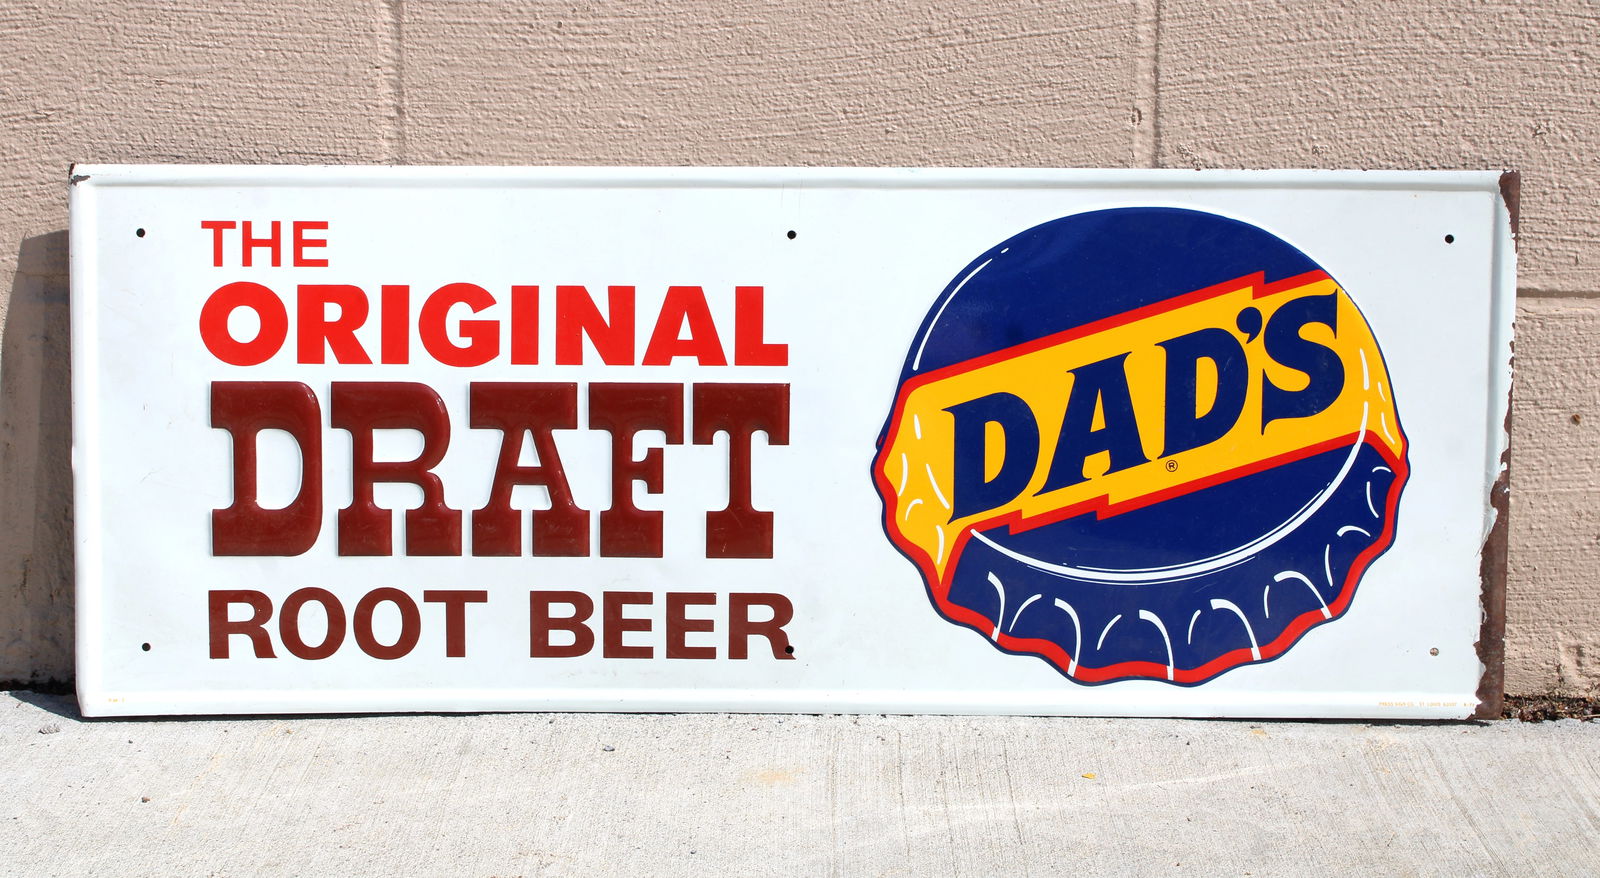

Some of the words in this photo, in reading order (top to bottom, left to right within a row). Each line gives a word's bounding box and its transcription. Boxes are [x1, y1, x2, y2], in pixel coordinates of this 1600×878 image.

[200, 220, 329, 268] THE
[199, 281, 789, 367] ORIGINAL
[943, 289, 1345, 524] DAD'S
[210, 381, 791, 559] DRAFT
[208, 588, 488, 660] ROOT
[530, 591, 795, 660] BEER
